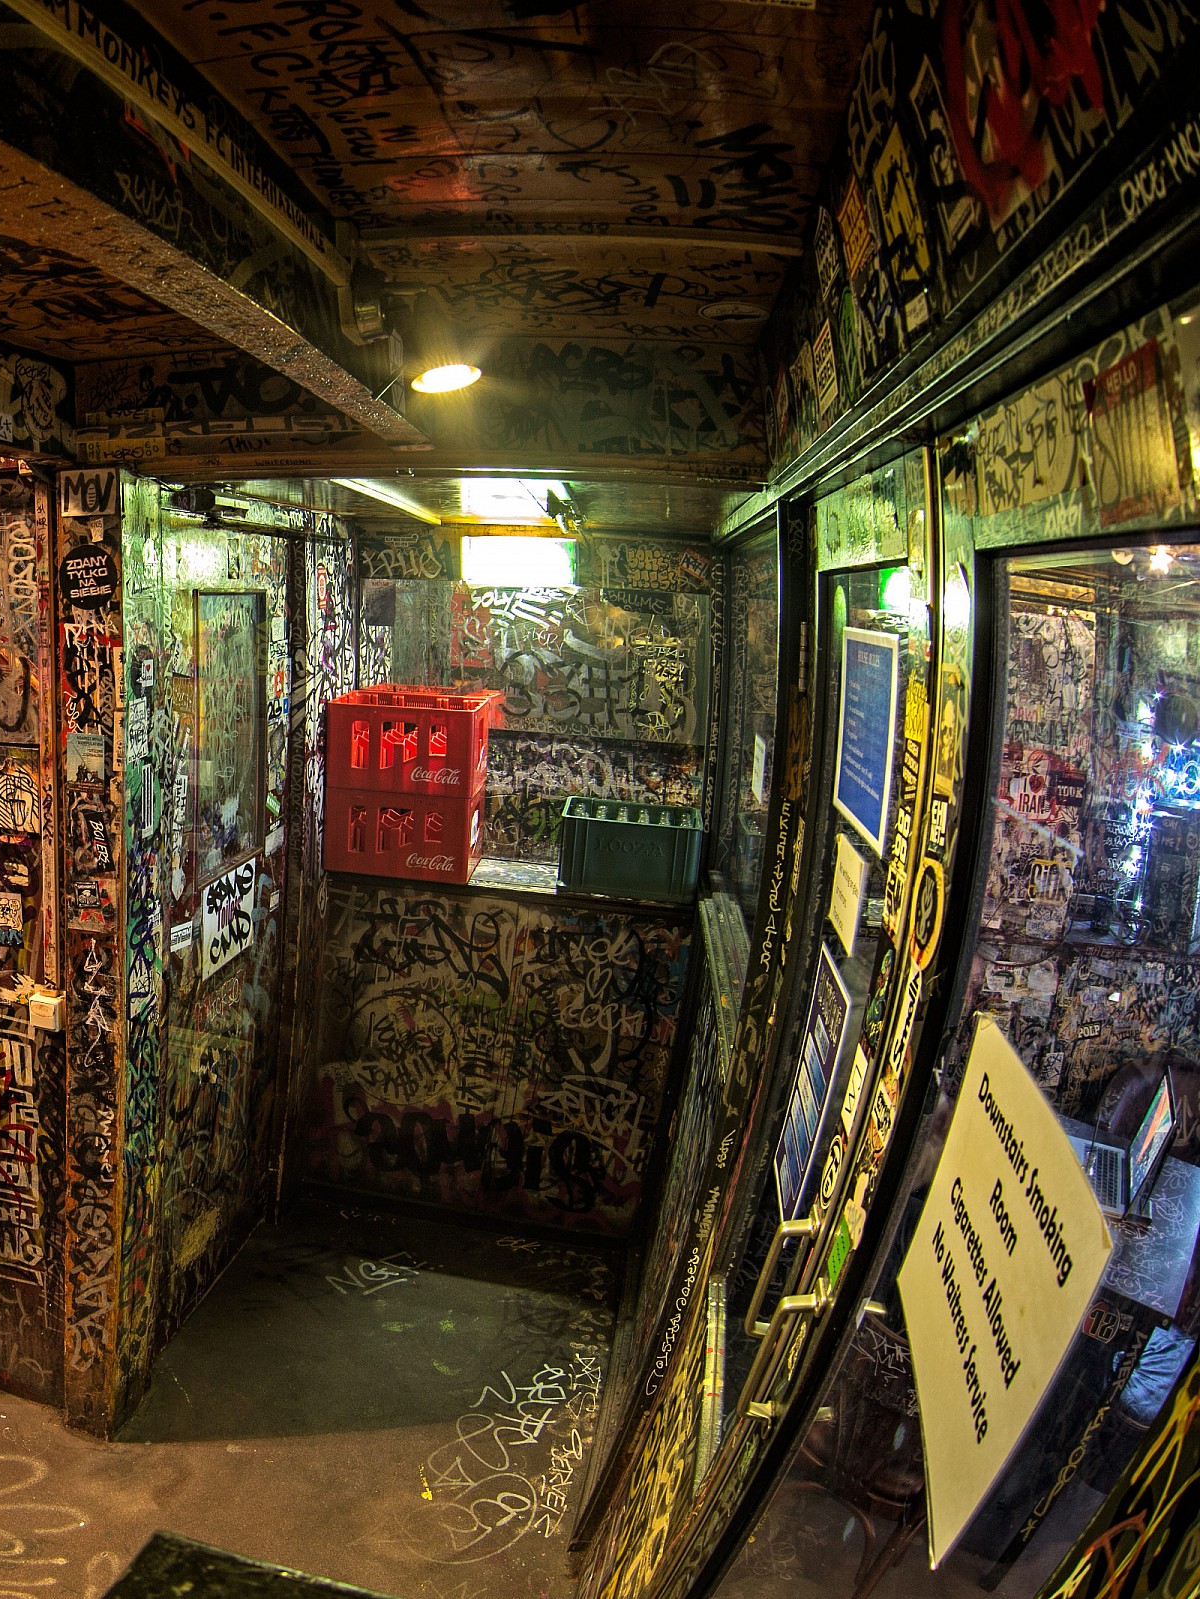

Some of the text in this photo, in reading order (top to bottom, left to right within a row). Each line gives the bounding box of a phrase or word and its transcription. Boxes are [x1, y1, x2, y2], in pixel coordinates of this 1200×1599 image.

[78, 8, 197, 130] MONKEYS
[1105, 360, 1137, 393] HELLO
[66, 556, 108, 570] ZDANY
[67, 568, 108, 579] TYLKO
[79, 578, 96, 588] NA
[411, 767, 460, 786] Coca-Cola
[1018, 793, 1044, 814] IRAN
[406, 853, 454, 871] Coca-Cola
[978, 1072, 1073, 1288] Downstairs Smoking
[989, 1178, 1017, 1257] Room
[951, 1177, 1021, 1391] Cigarettes Allowed
[932, 1220, 988, 1445] No Waitress Service
